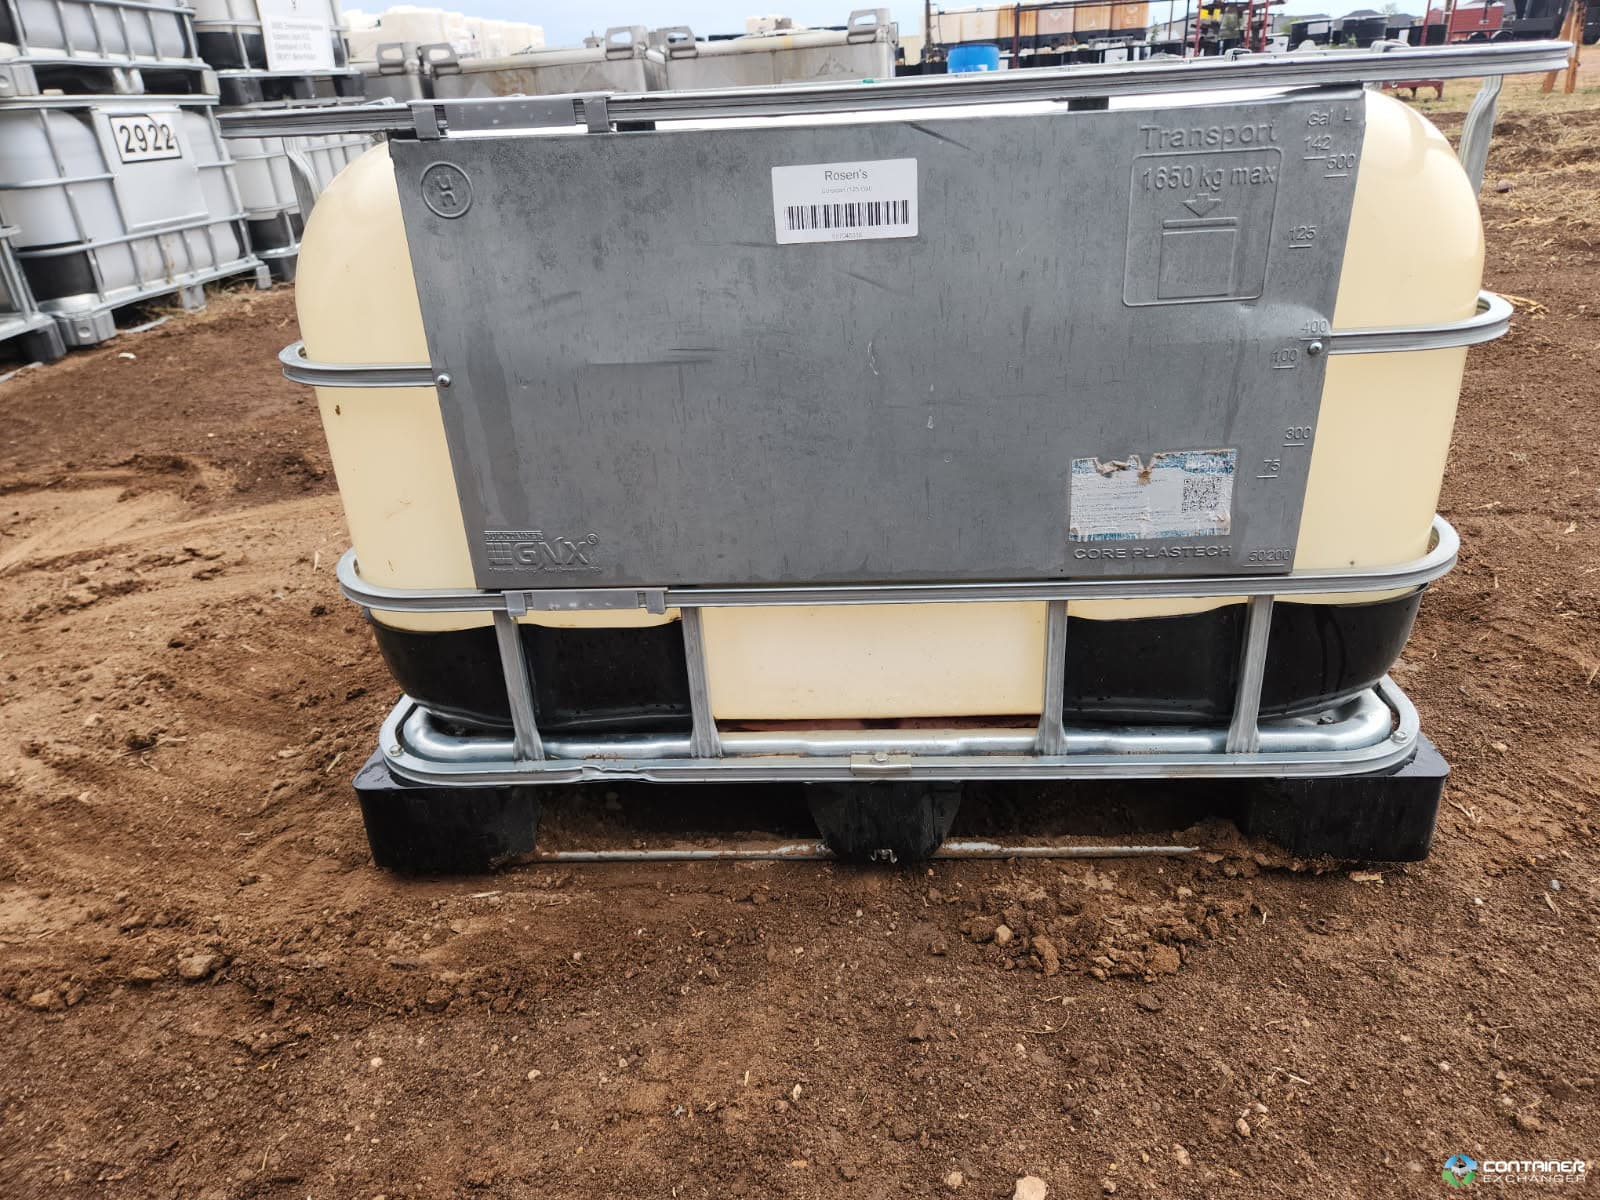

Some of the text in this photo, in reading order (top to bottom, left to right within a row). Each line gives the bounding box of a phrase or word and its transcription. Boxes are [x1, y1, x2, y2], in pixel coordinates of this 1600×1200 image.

[1307, 107, 1353, 127] Gal L
[119, 122, 175, 154] 2922
[1140, 120, 1278, 150] Transport
[1303, 135, 1332, 151] 142
[1326, 153, 1357, 170] 500
[824, 168, 869, 181] Rosen's
[1142, 164, 1278, 193] 1650 kg max
[1289, 225, 1318, 242] 125
[1301, 320, 1328, 335] 400
[1272, 349, 1298, 364] 100
[1284, 426, 1312, 441] 300
[1262, 458, 1282, 472] 75
[1073, 544, 1233, 561] CORE PLASTECH
